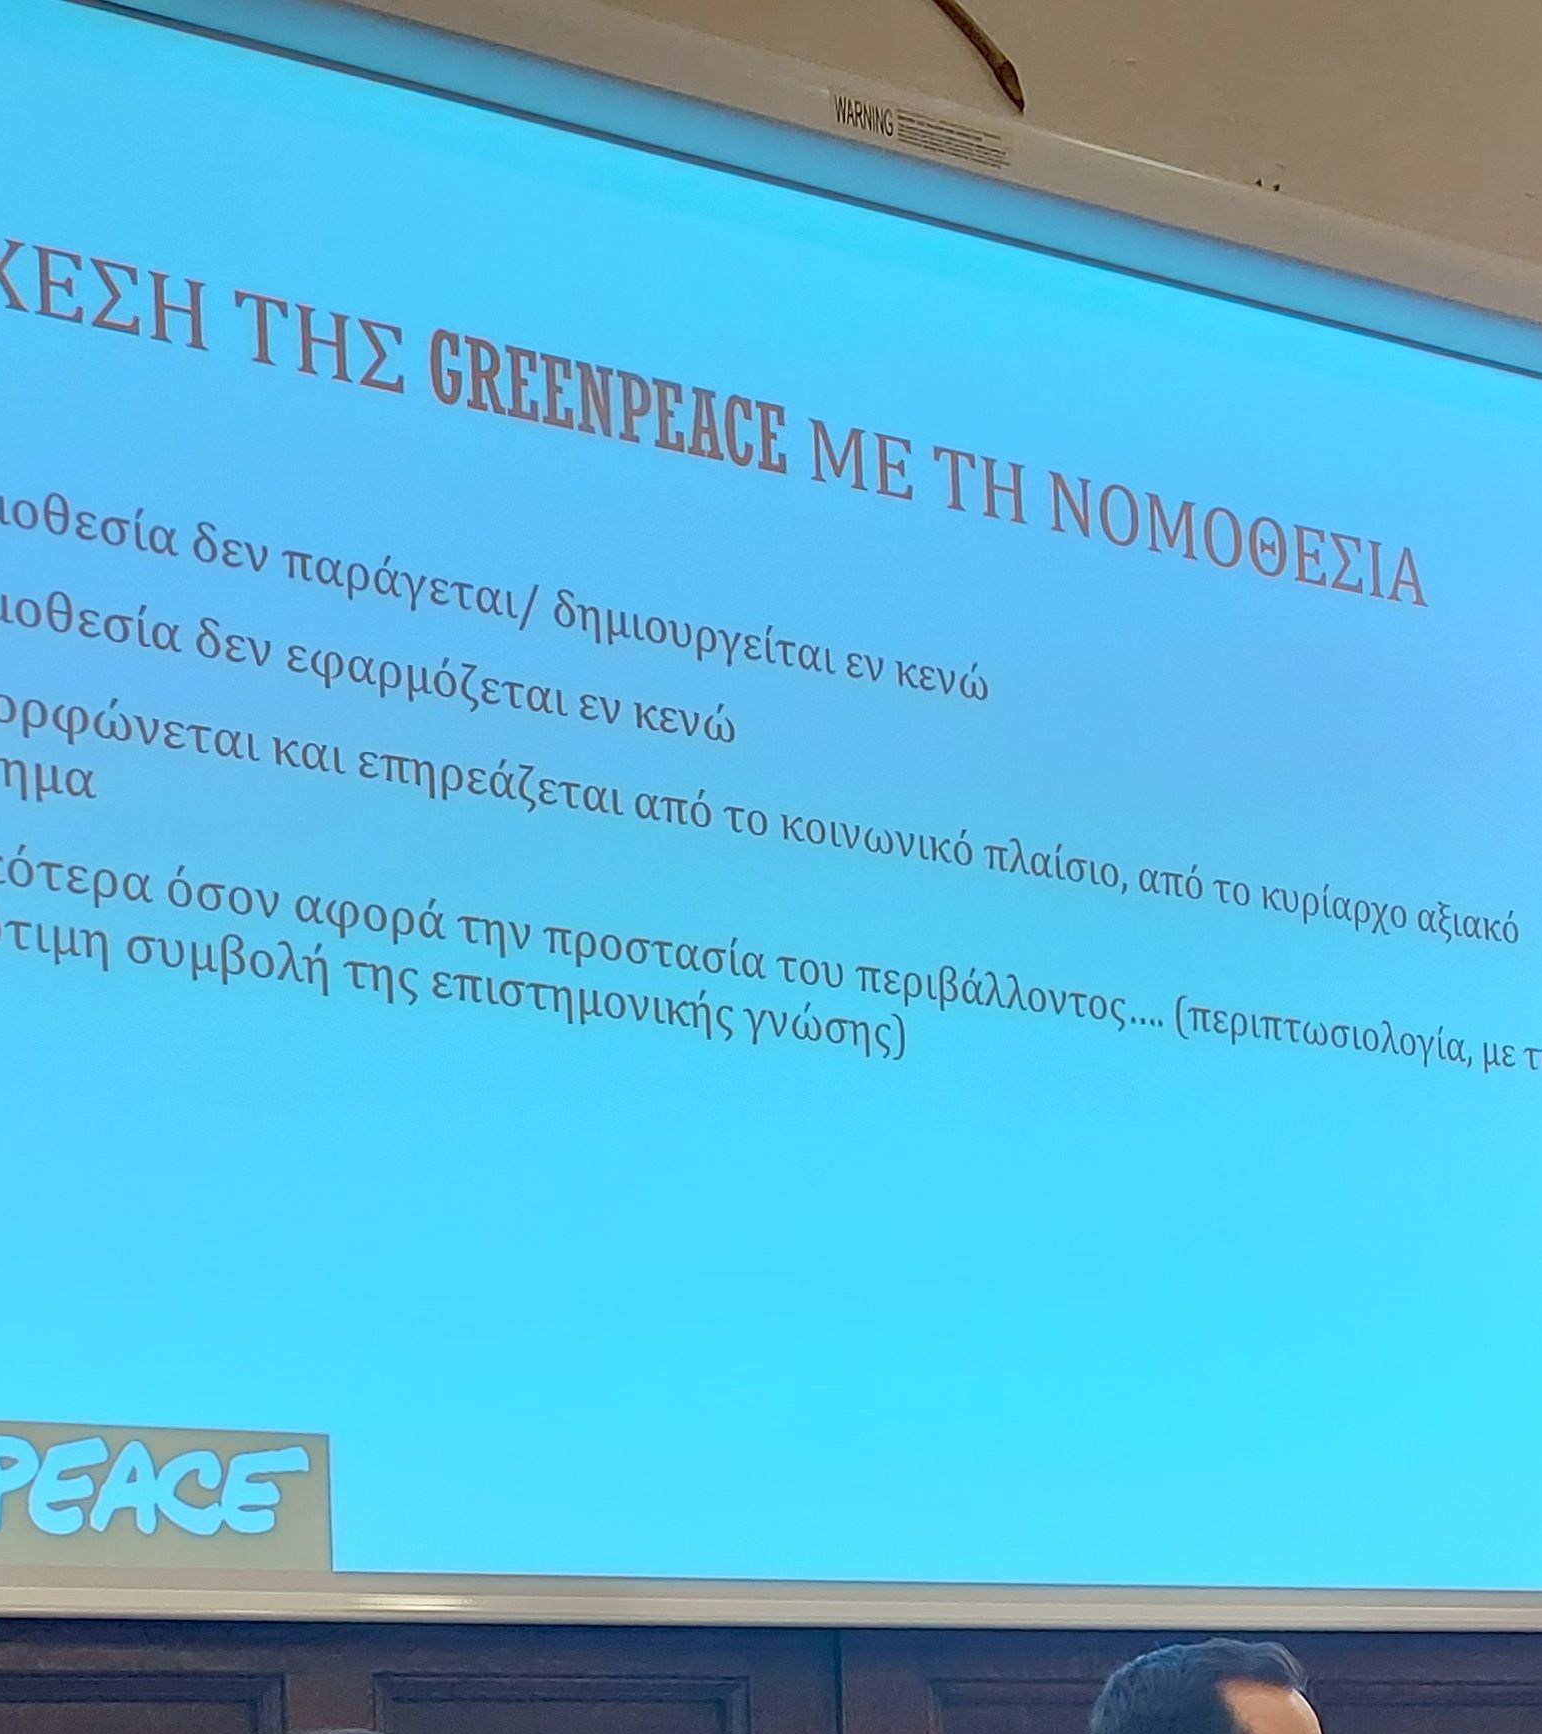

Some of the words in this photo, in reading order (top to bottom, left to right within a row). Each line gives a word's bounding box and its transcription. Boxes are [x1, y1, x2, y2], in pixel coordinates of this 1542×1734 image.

[833, 95, 894, 137] WARNING
[233, 289, 405, 395] ΤΗΣ
[429, 327, 788, 475] GREENPEACE
[808, 417, 914, 501] ΜΕ
[932, 444, 1028, 525] ΤΗ
[1047, 469, 1429, 608] ΝΟΜΟΘΕΣΙΑ
[192, 520, 269, 573] δεν
[280, 549, 540, 632] παράγεται/
[553, 588, 837, 675] δημιουργείται
[846, 652, 884, 683] εν
[895, 659, 989, 701] κενώ
[195, 616, 272, 667] δεν
[287, 644, 569, 717] εφαρμόζεται
[579, 693, 622, 725] εν
[633, 701, 736, 744] κενώ
[271, 736, 347, 775] και
[358, 751, 625, 816] επηρεάζεται
[634, 788, 712, 828] από
[722, 805, 768, 837] το
[780, 813, 973, 867] κοινωνικό
[982, 837, 1128, 896] πλαίσιο,
[1138, 863, 1204, 900] από
[1212, 879, 1251, 907] το
[1260, 882, 1408, 936] κυρίαρχο
[1417, 900, 1520, 945] αξιακό
[126, 933, 329, 997] συμβολή
[342, 960, 419, 1007] της
[431, 971, 734, 1043] επιστημονικής
[742, 1001, 906, 1061] γνώσης)
[167, 864, 280, 919] όσον
[294, 894, 447, 946] αφορά
[456, 915, 531, 959] την
[542, 926, 767, 980] προστασία
[775, 955, 844, 989] του
[1175, 994, 1473, 1069] (περιπτωσιολογία,
[1482, 1041, 1517, 1074] με
